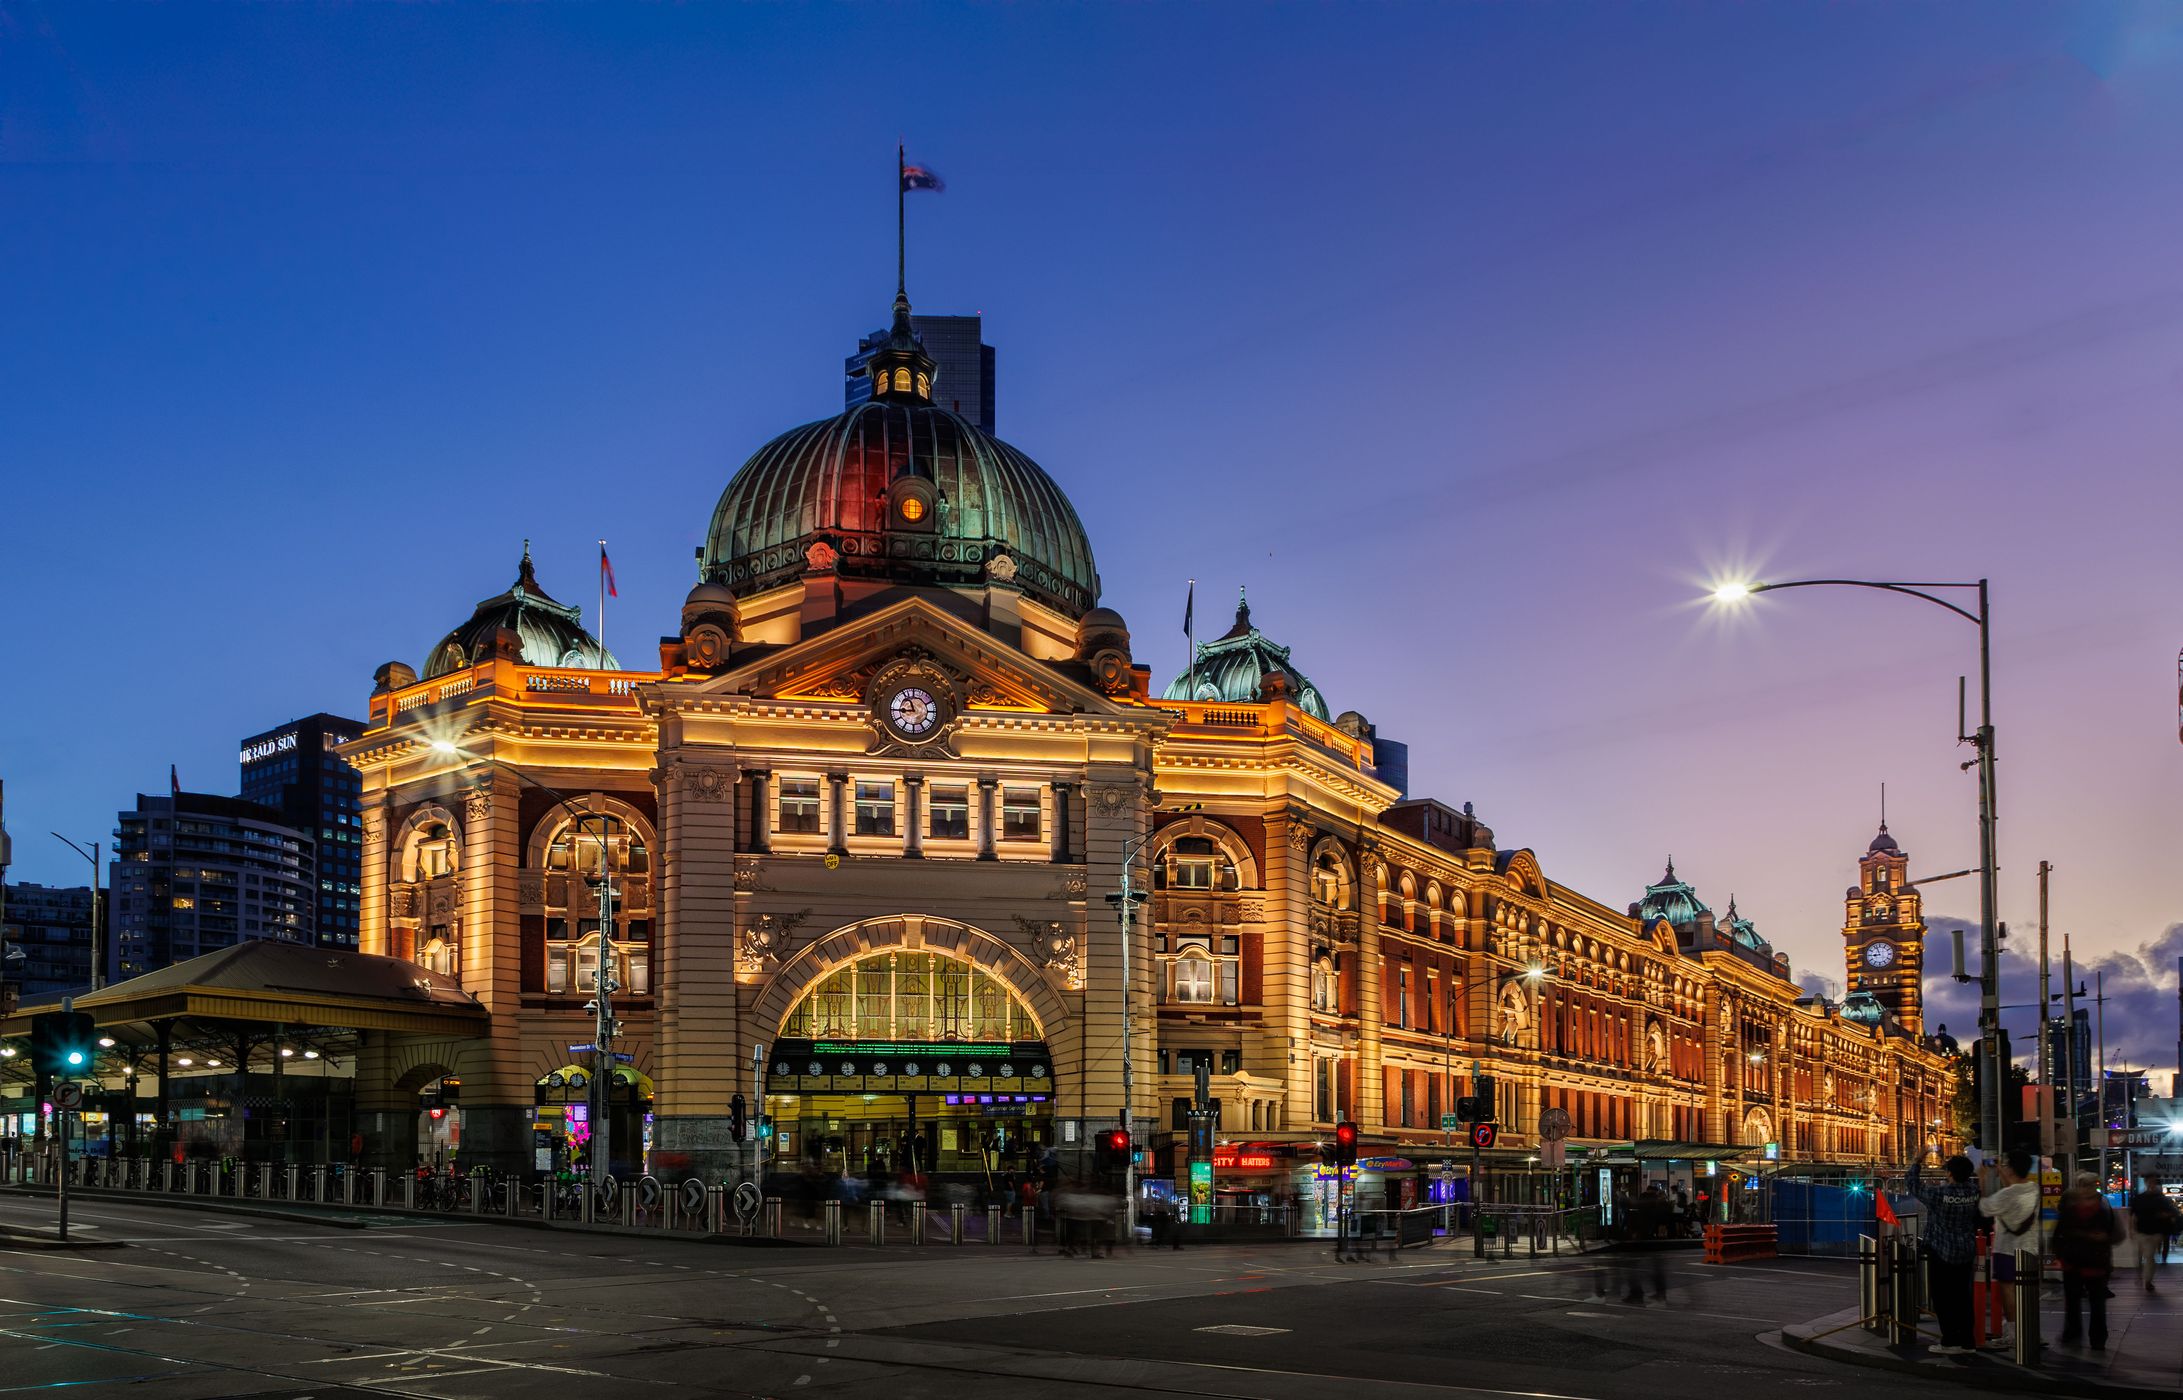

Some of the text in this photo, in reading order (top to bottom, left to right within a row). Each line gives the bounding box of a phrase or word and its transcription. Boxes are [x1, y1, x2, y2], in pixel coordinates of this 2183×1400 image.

[278, 734, 297, 751] SUN
[1241, 1157, 1270, 1167] HATTERS
[1373, 1161, 1403, 1169] EzyMart
